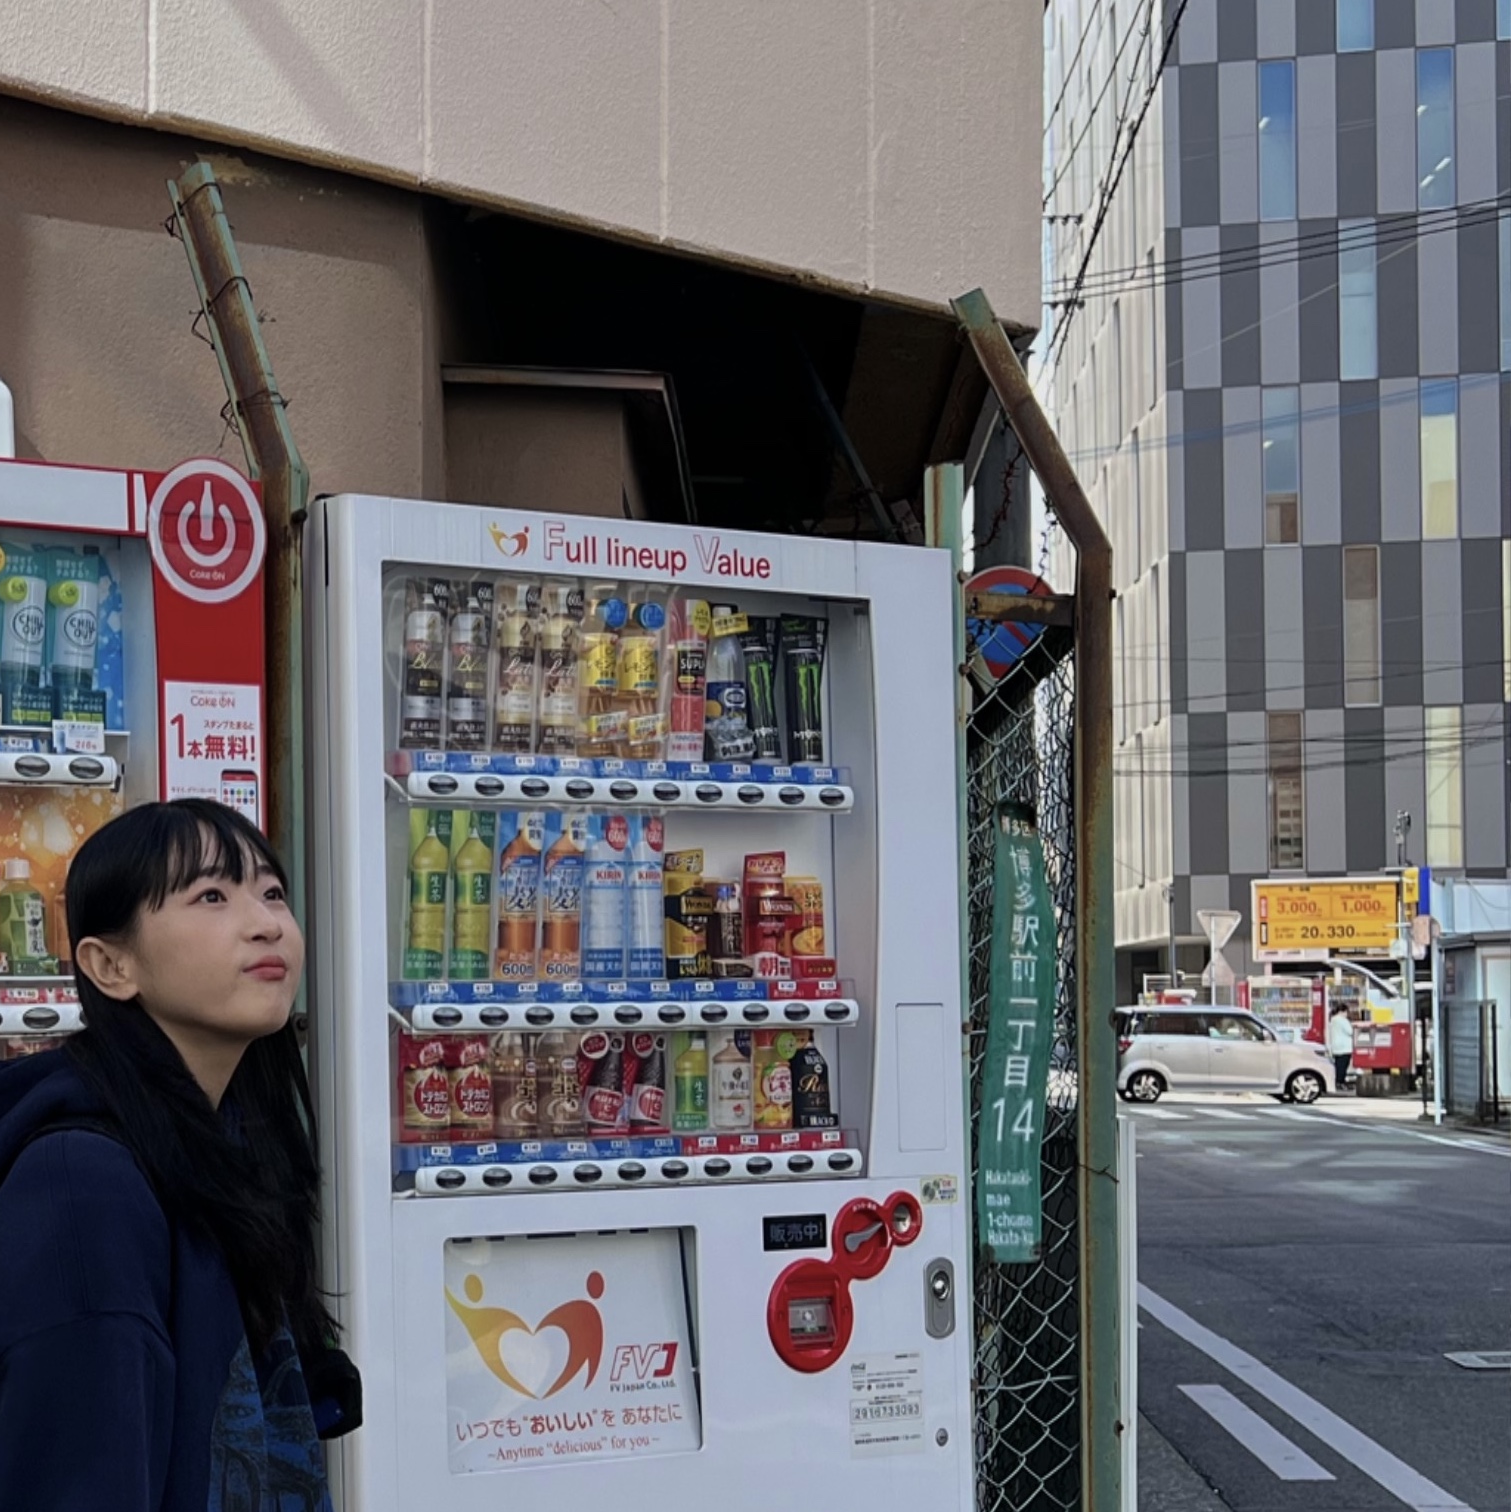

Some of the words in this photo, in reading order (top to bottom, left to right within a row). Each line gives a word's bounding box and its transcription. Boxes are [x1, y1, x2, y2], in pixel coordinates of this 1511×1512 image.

[542, 519, 597, 566] Full
[606, 537, 688, 574] lineup
[692, 533, 773, 580] Value
[189, 568, 211, 581] Coke
[212, 570, 226, 582] ON
[190, 695, 217, 709] Coke
[218, 695, 236, 709] ON
[596, 869, 622, 880] KIRIN
[1004, 844, 1039, 1088] 博多駅前一丁目
[991, 1097, 1035, 1142] 14
[986, 1192, 1012, 1207] mae
[769, 1222, 819, 1243] 販売中
[609, 1382, 621, 1393] FV
[622, 1381, 645, 1394] Japan
[622, 1403, 683, 1426] あなたに
[611, 1435, 627, 1449] for
[629, 1436, 650, 1450] you
